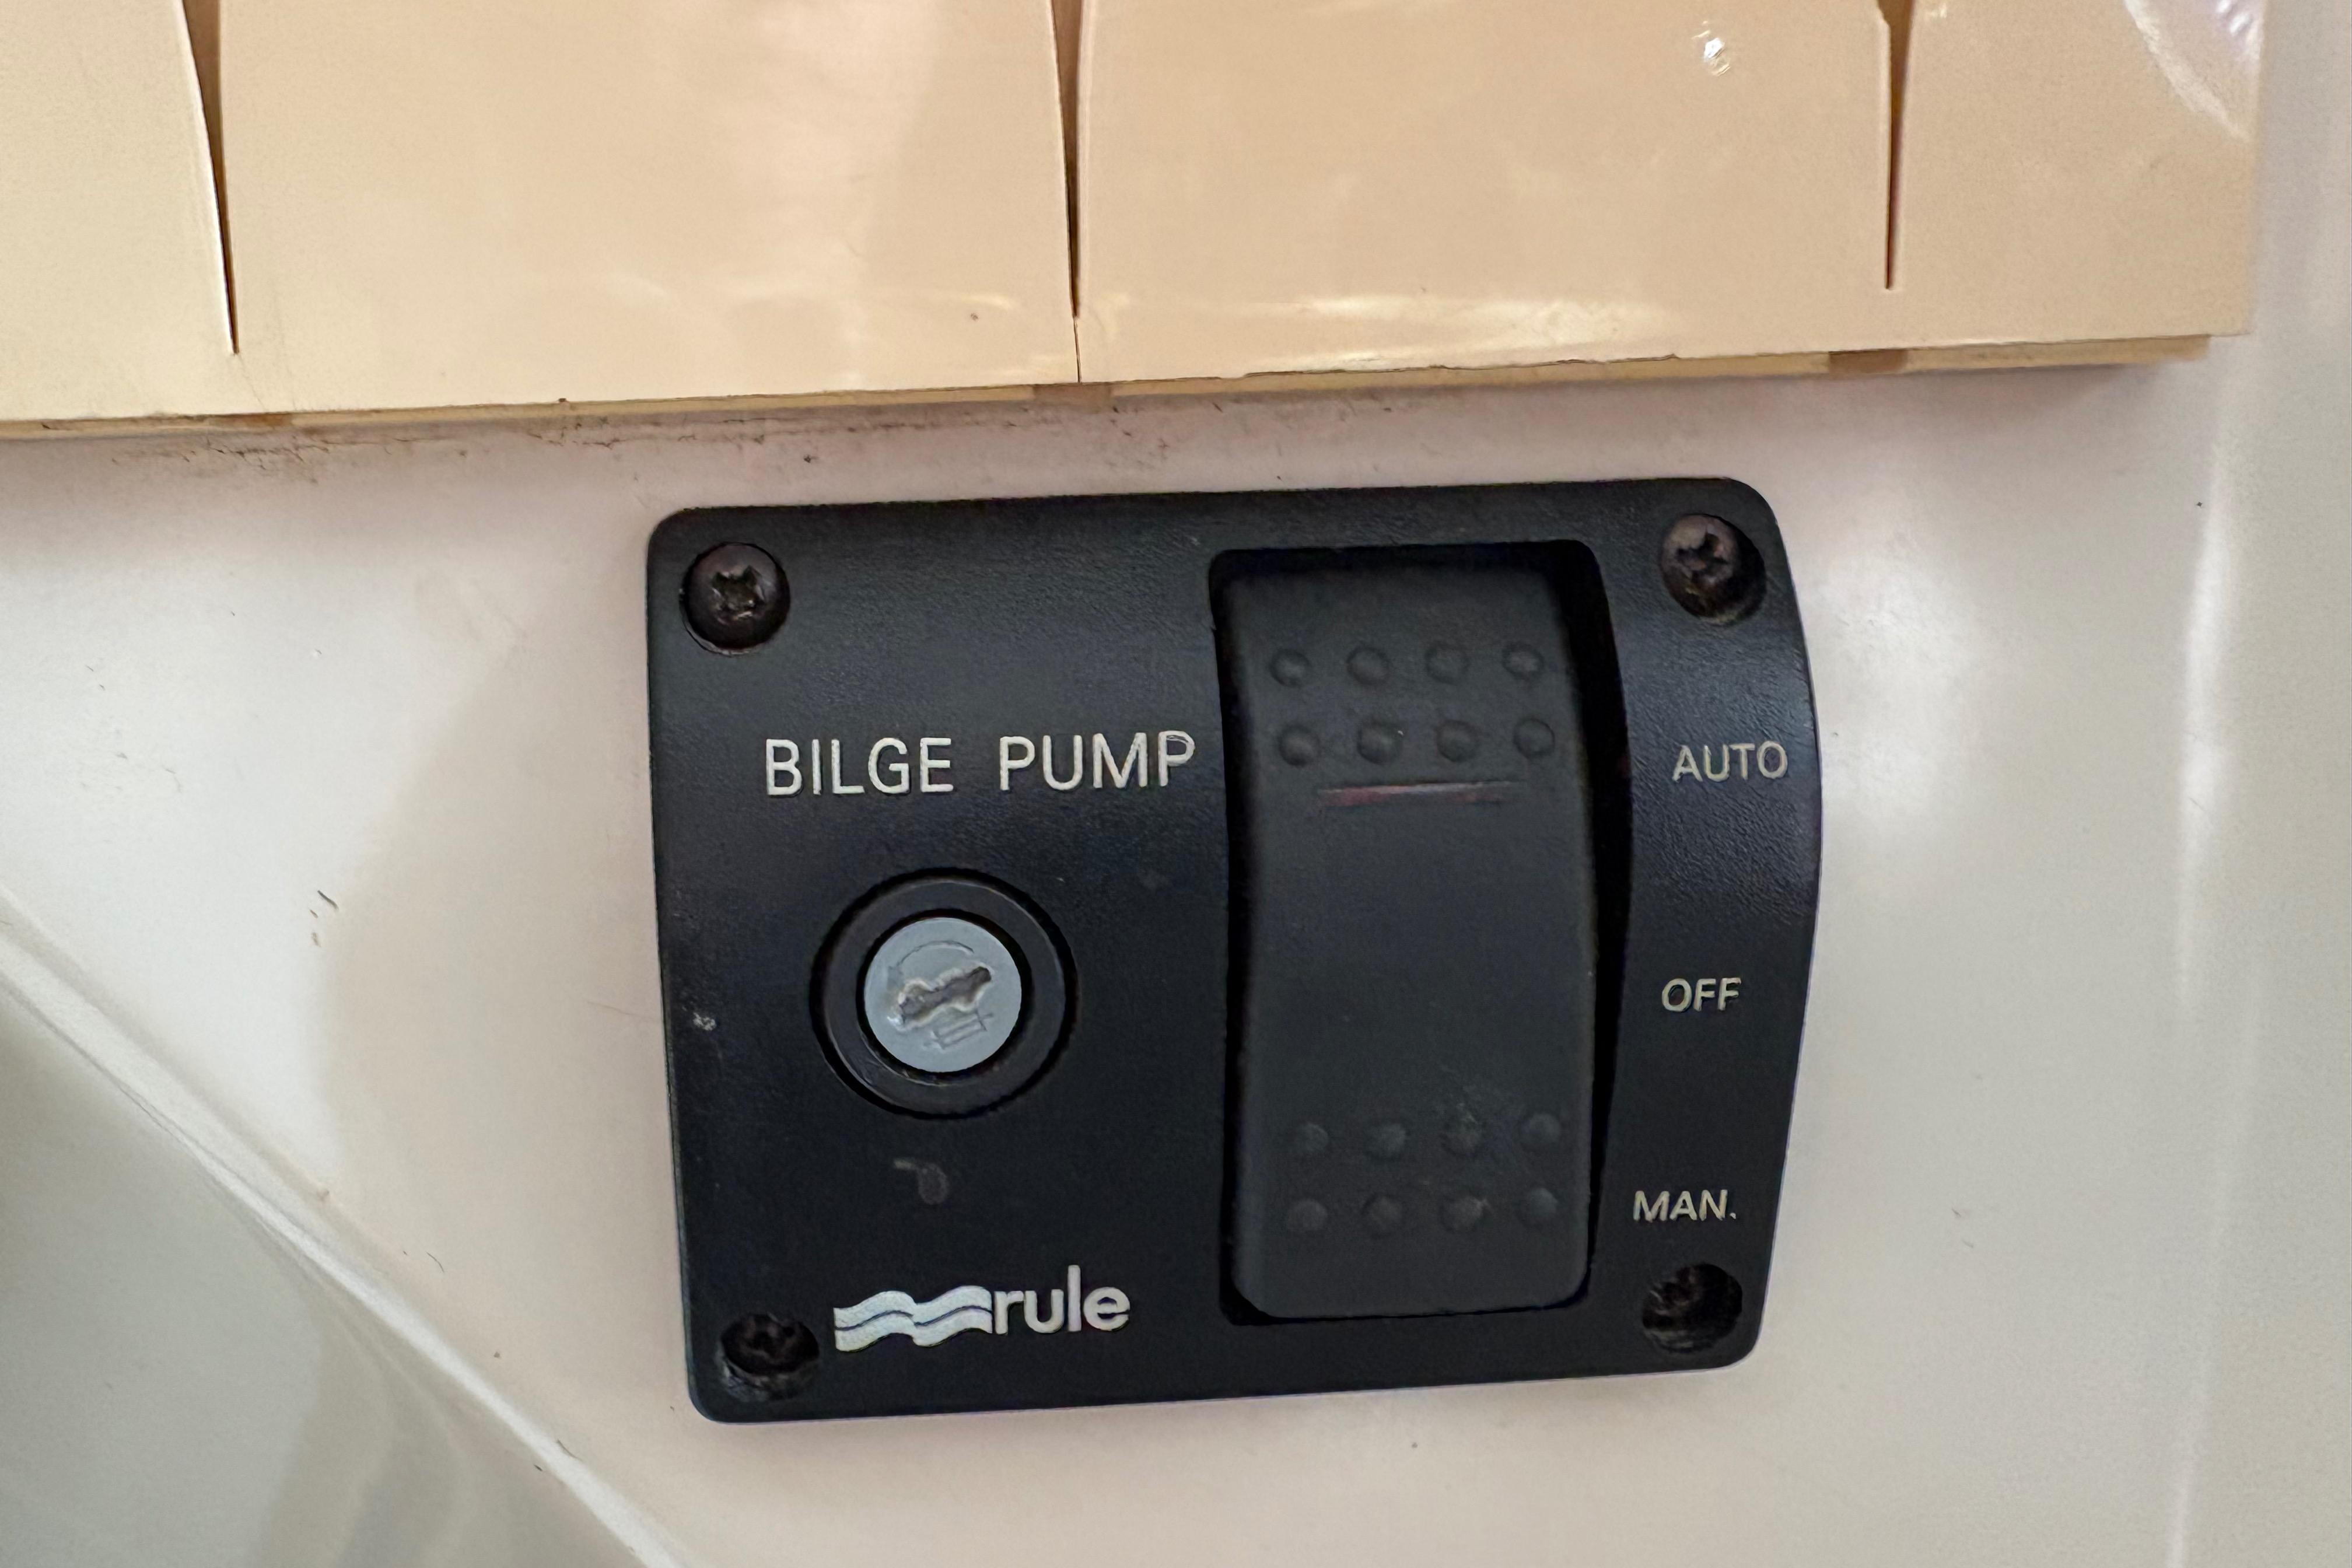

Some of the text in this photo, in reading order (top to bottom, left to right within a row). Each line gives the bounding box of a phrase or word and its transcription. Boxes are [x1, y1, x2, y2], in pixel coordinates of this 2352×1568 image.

[765, 729, 1196, 796] BILGE PUMP
[1671, 740, 1788, 782] AUTO
[1661, 977, 1742, 1012] OFF
[1633, 1189, 1737, 1222] MAN.
[994, 1264, 1130, 1335] rule
